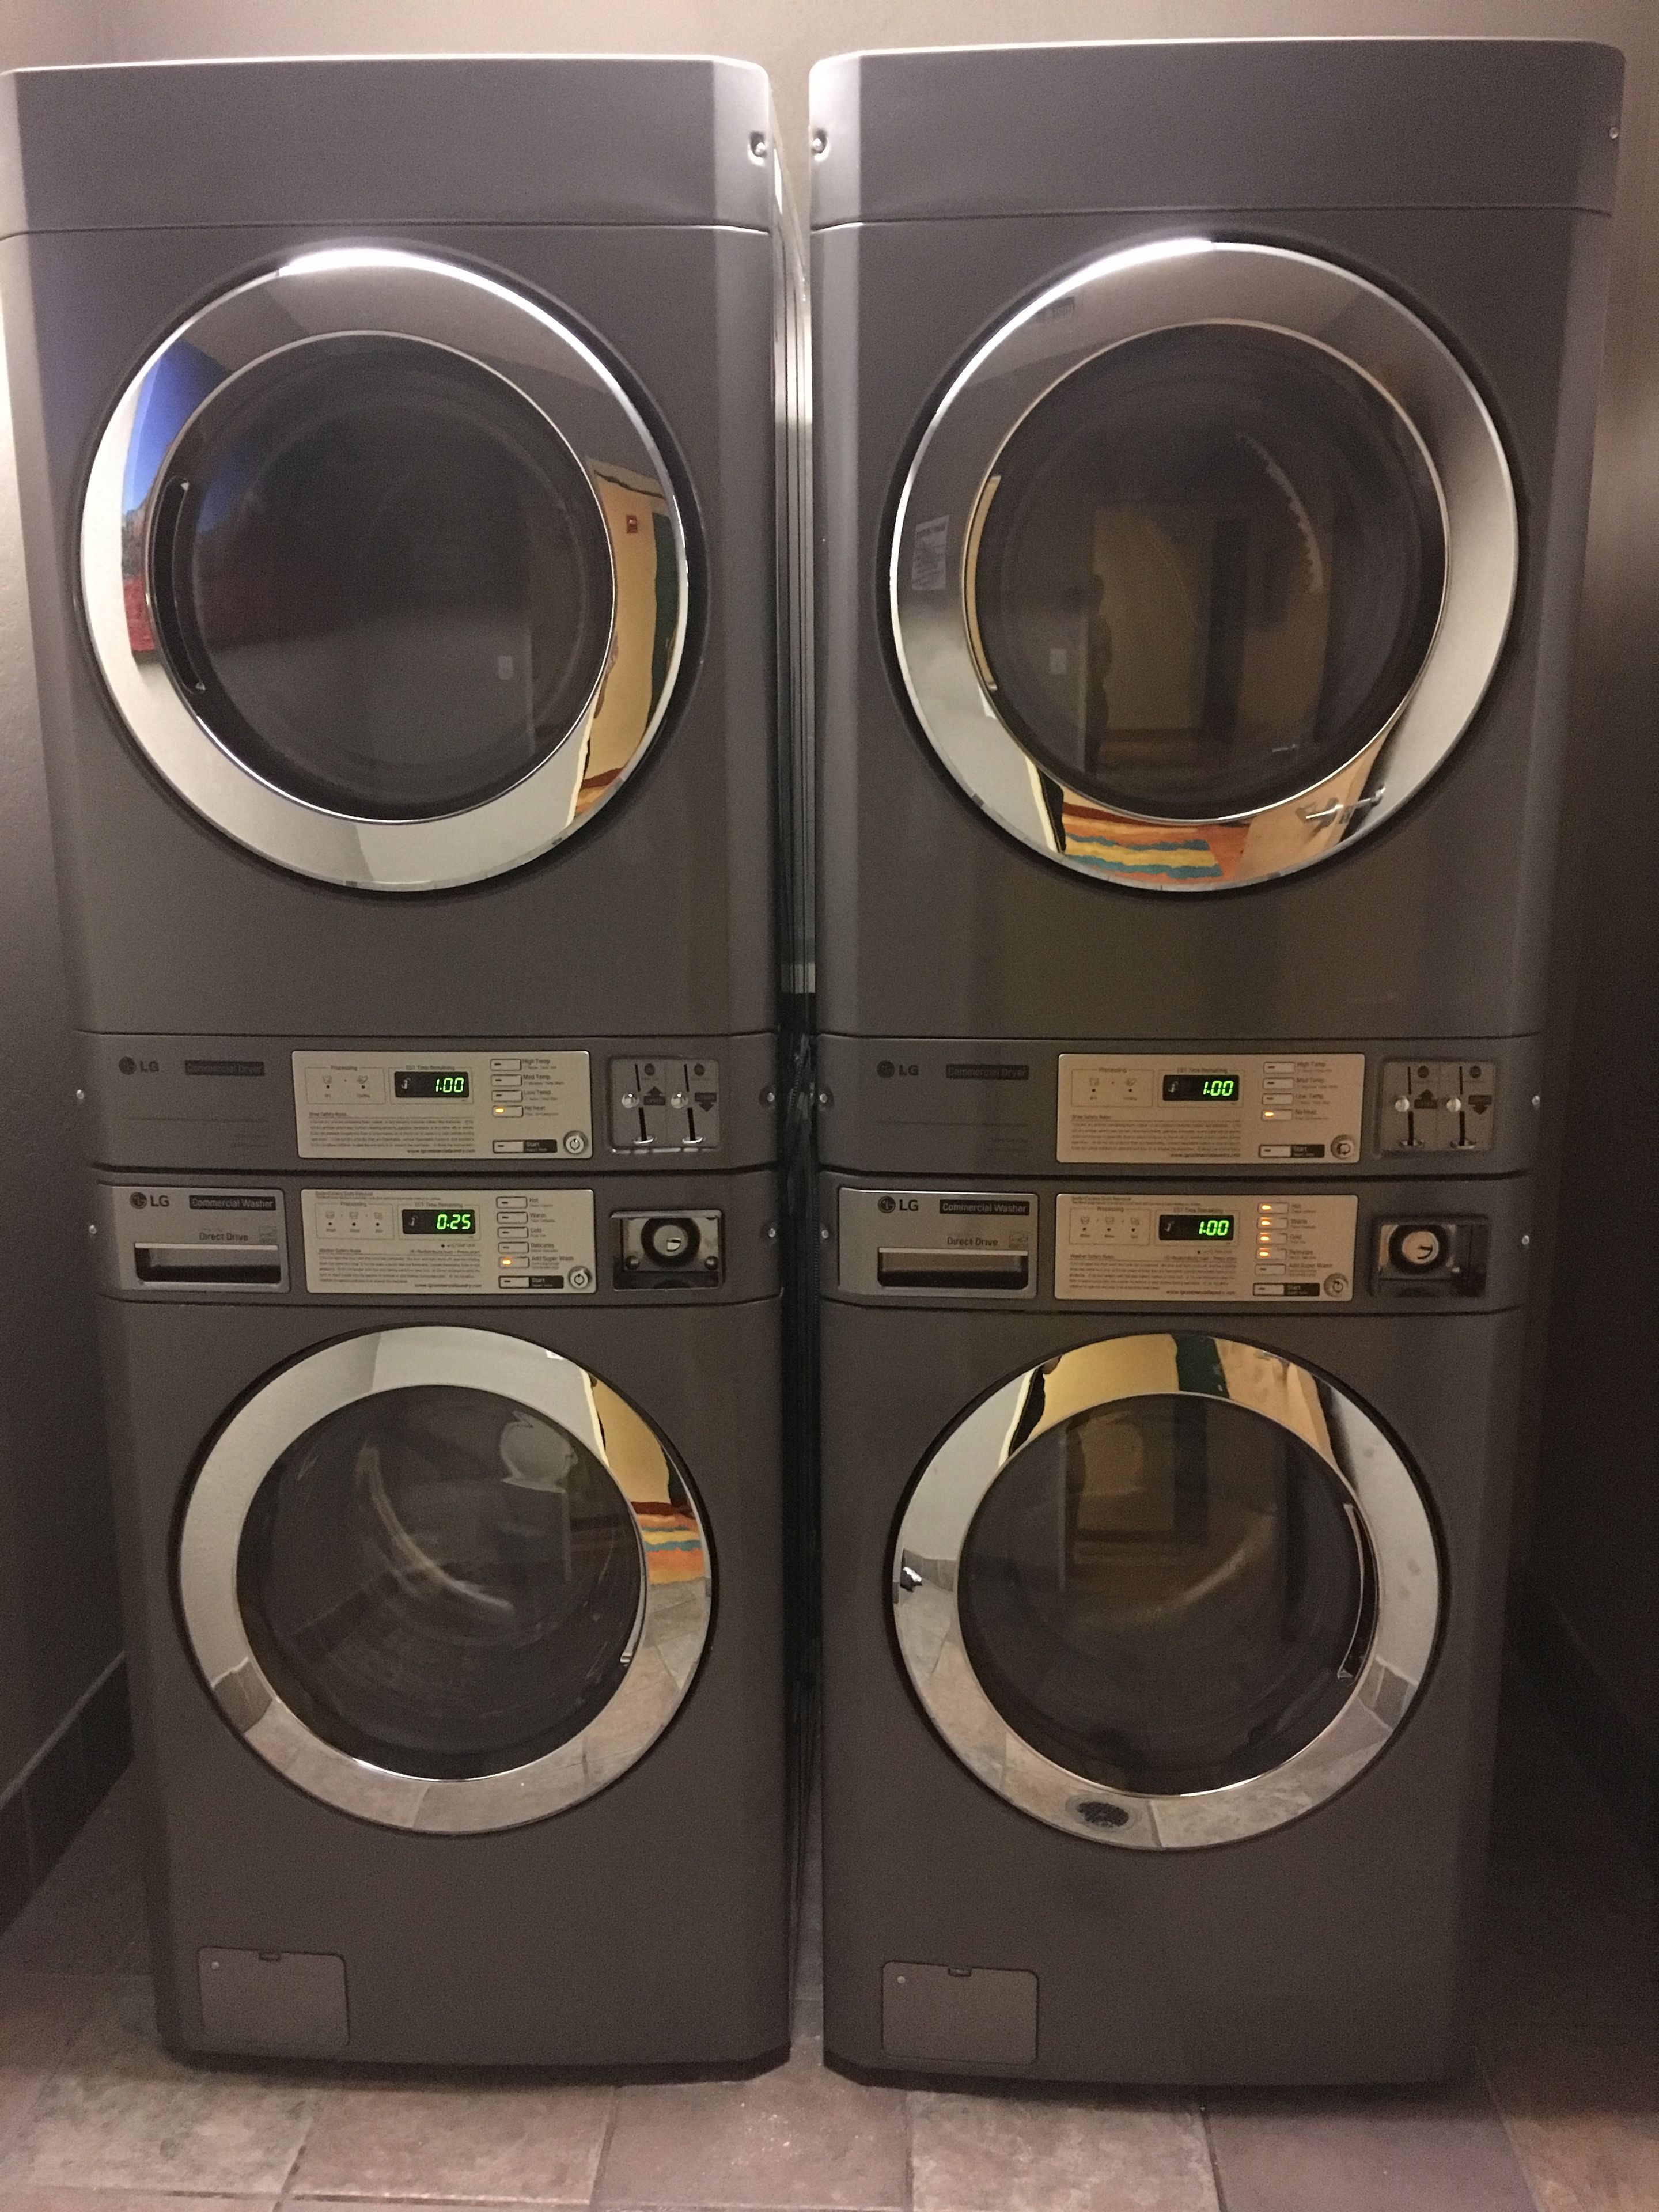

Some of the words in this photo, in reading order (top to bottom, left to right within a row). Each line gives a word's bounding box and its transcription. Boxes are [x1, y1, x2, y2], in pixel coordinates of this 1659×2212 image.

[139, 1060, 160, 1073] LG
[899, 1065, 919, 1076] LG
[150, 1195, 170, 1207] LG
[192, 1197, 240, 1207] Commercial
[242, 1198, 274, 1207] Washer
[899, 1199, 919, 1211] LG
[942, 1202, 991, 1212] Commercial
[993, 1203, 1027, 1213] Washer
[199, 1233, 224, 1241] Direct
[226, 1233, 248, 1241] Drive
[947, 1237, 974, 1246] Direct
[976, 1237, 998, 1246] Drive
